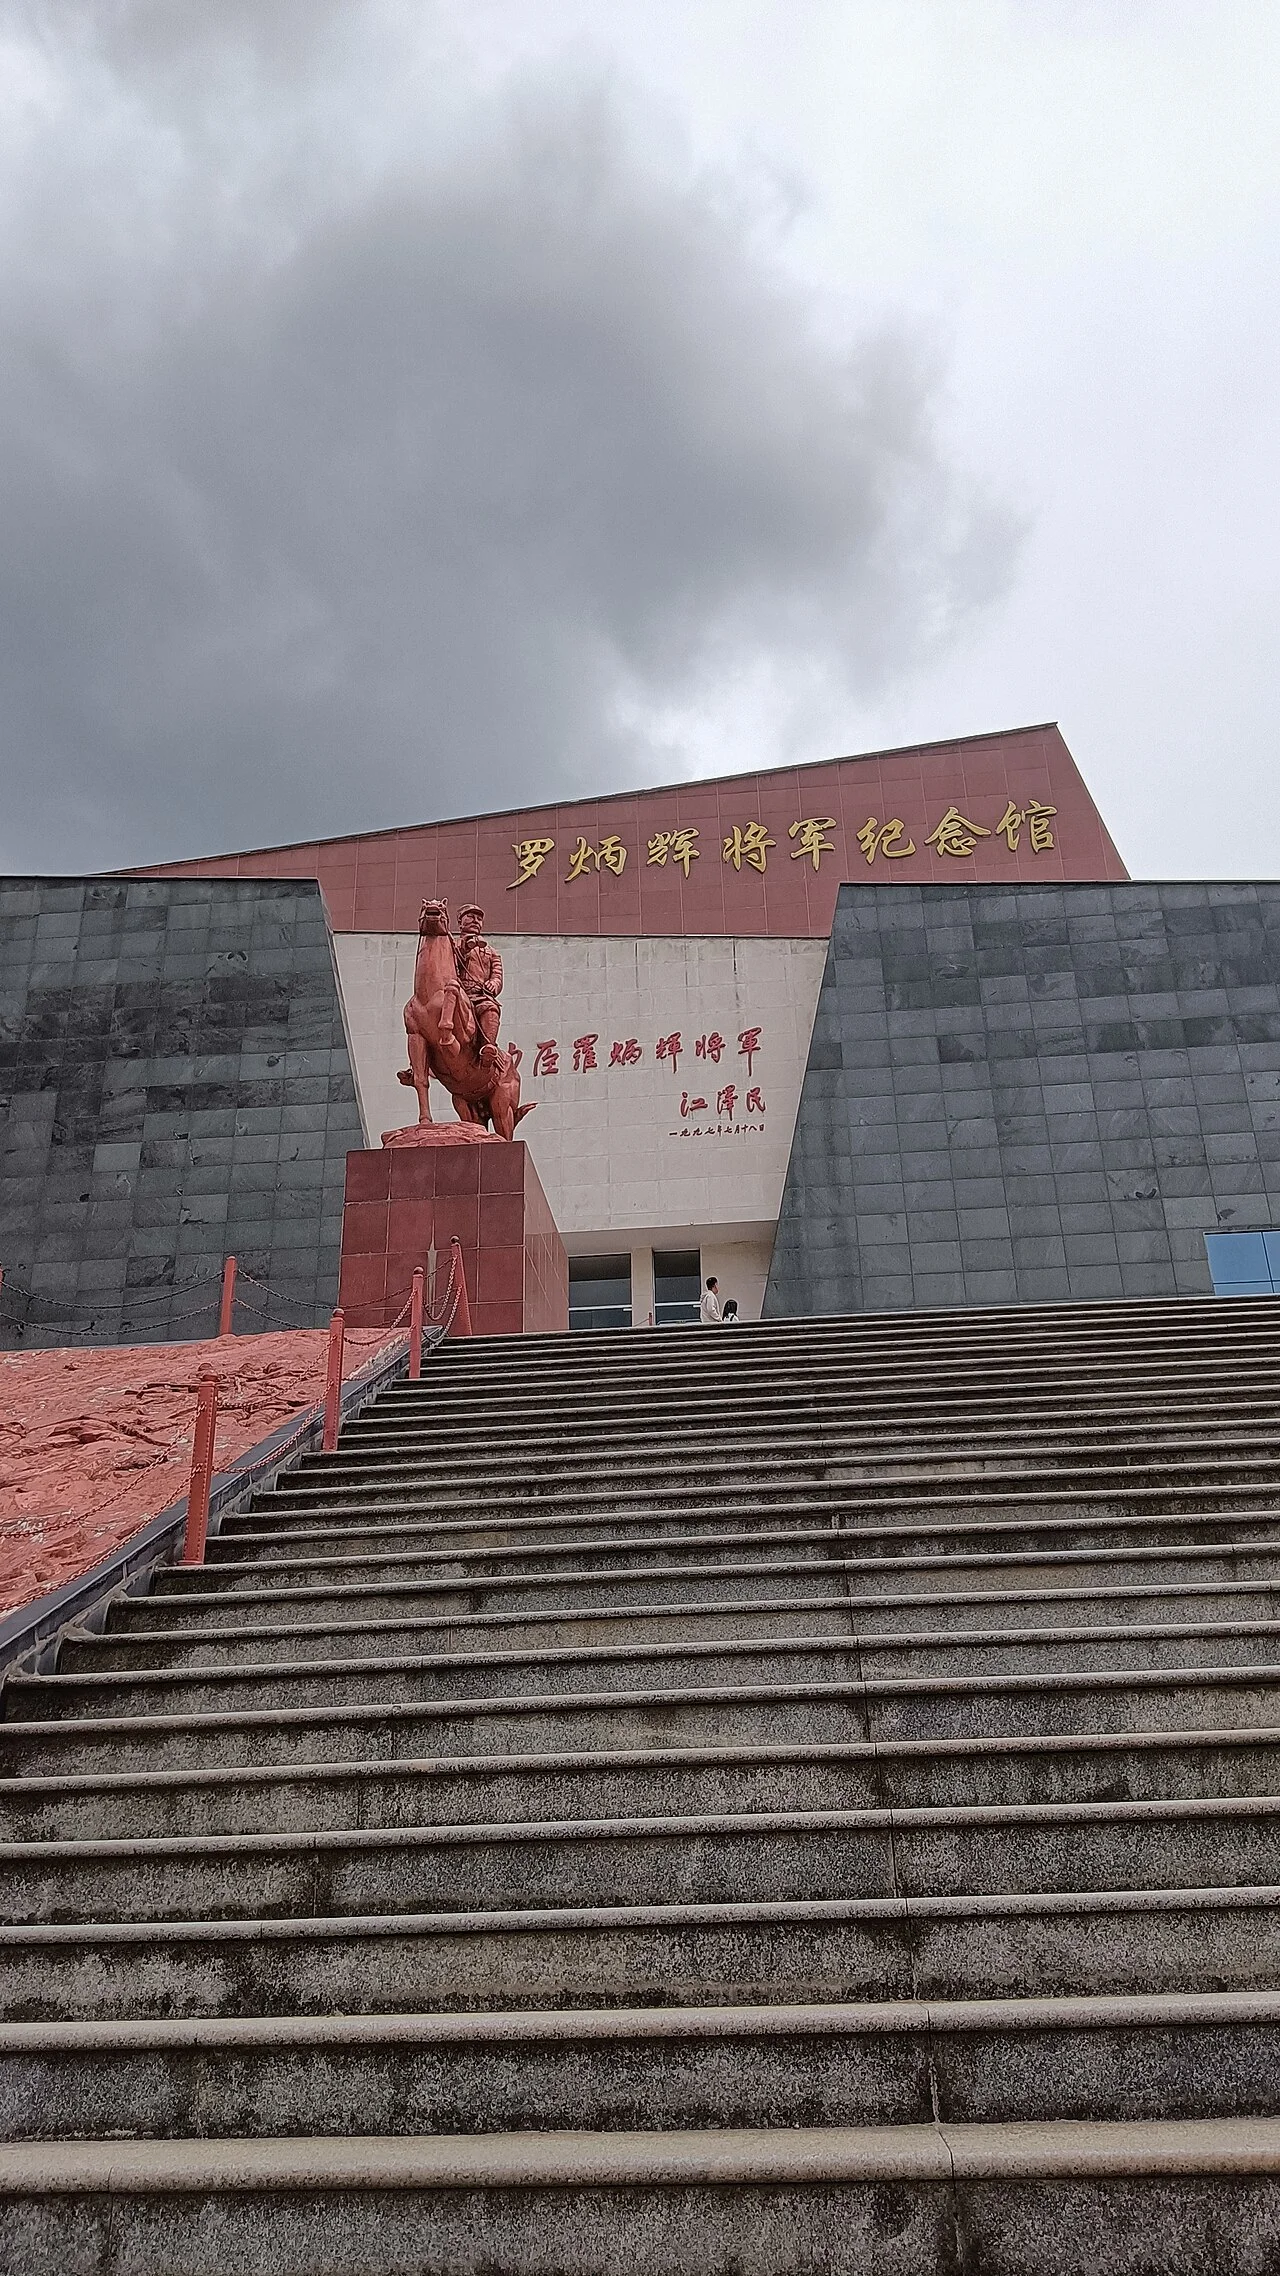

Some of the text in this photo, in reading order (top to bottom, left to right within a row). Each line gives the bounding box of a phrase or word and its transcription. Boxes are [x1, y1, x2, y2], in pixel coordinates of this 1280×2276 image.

[506, 800, 1057, 889] 罗炳辉将军纪念馆
[669, 1124, 765, 1137] 一九九七年七月十八日
